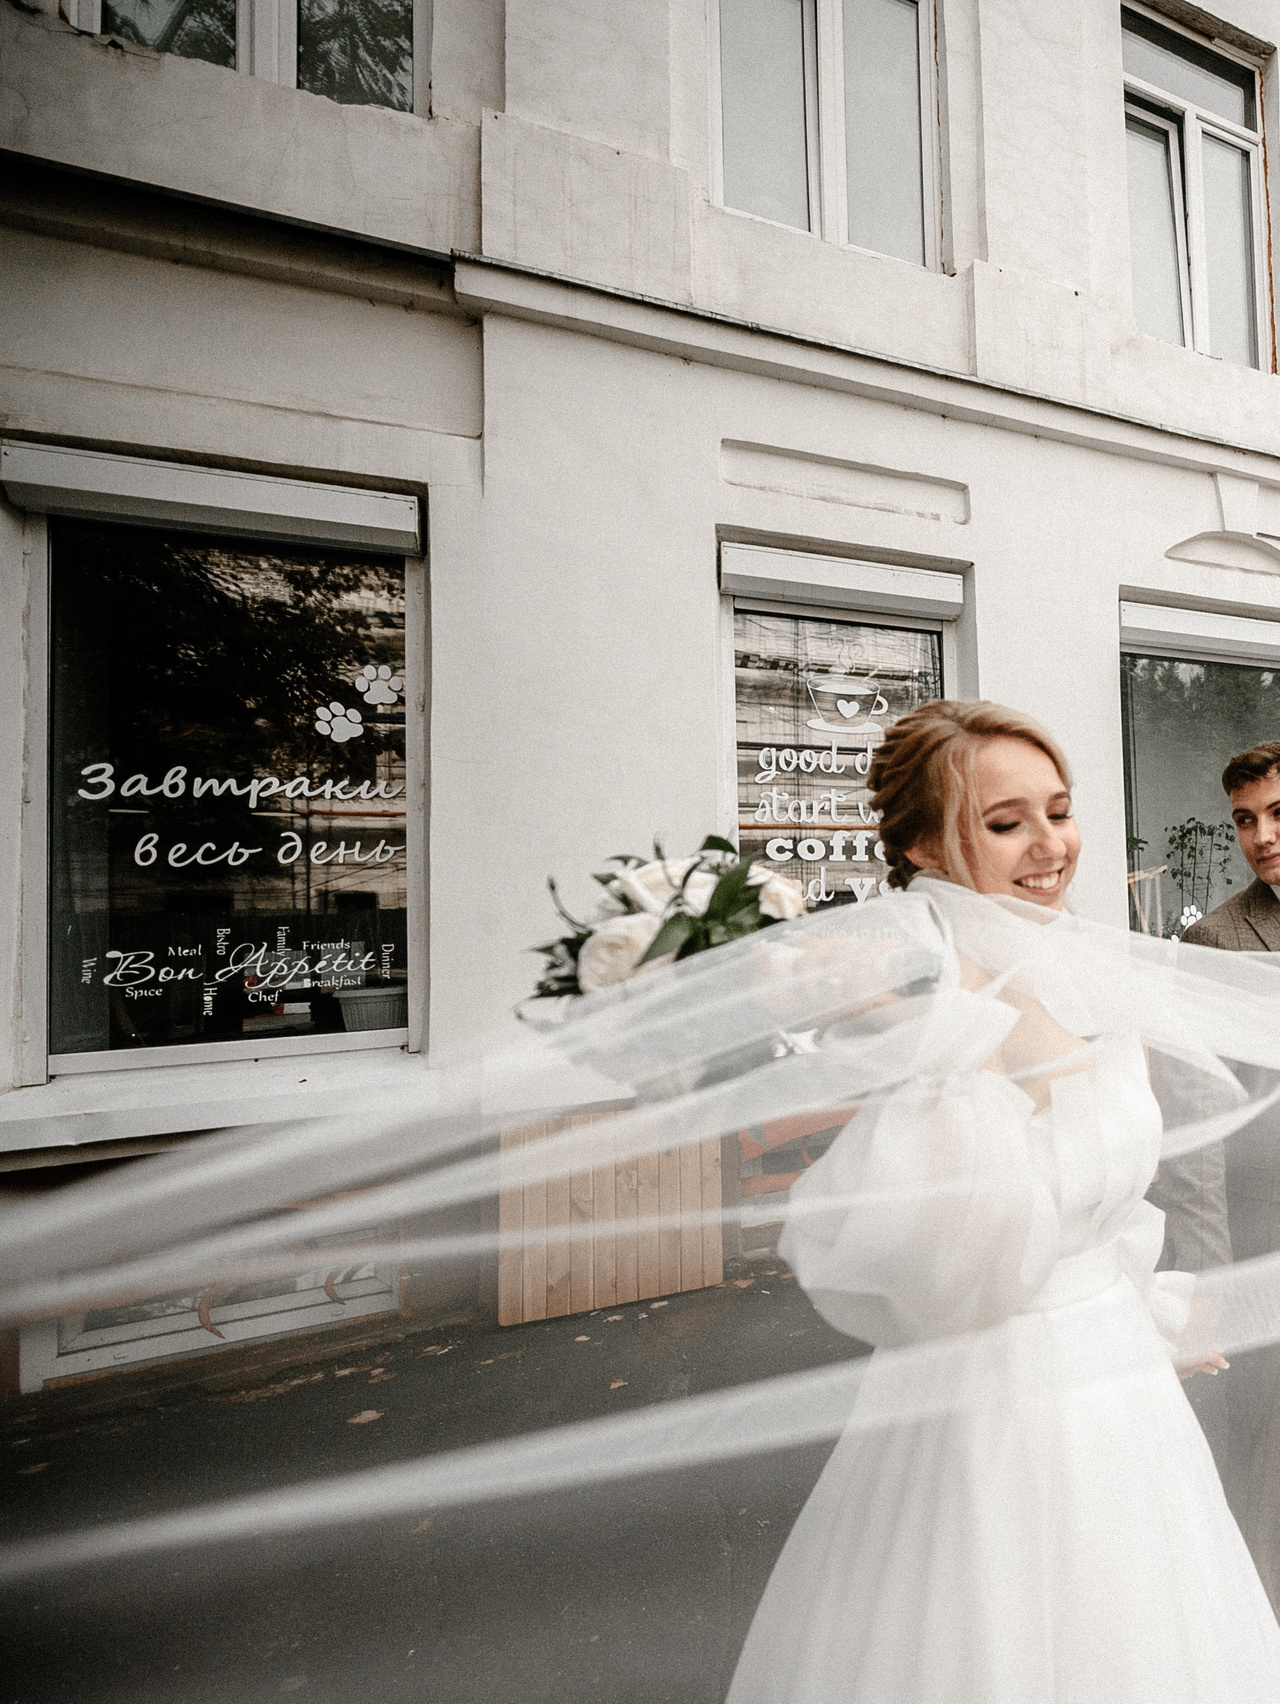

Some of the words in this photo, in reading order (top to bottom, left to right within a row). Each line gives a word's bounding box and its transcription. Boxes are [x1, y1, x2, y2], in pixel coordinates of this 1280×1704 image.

[755, 740, 846, 784] good
[77, 763, 406, 809] Завтраки
[755, 787, 849, 823] start
[134, 833, 263, 867] весь
[277, 832, 406, 865] день
[766, 830, 887, 861] coff
[168, 944, 202, 957] Meal
[216, 928, 231, 956] Bistro
[272, 926, 292, 956] Family
[302, 938, 351, 951] Friends
[81, 957, 98, 984] Wine
[103, 950, 204, 987] Bon
[203, 942, 377, 988] Appétit
[381, 943, 395, 980] Dinner
[125, 986, 163, 1000] Spice
[248, 989, 283, 1005] Chef
[303, 975, 362, 990] Breakfast
[203, 987, 218, 1016] Home
